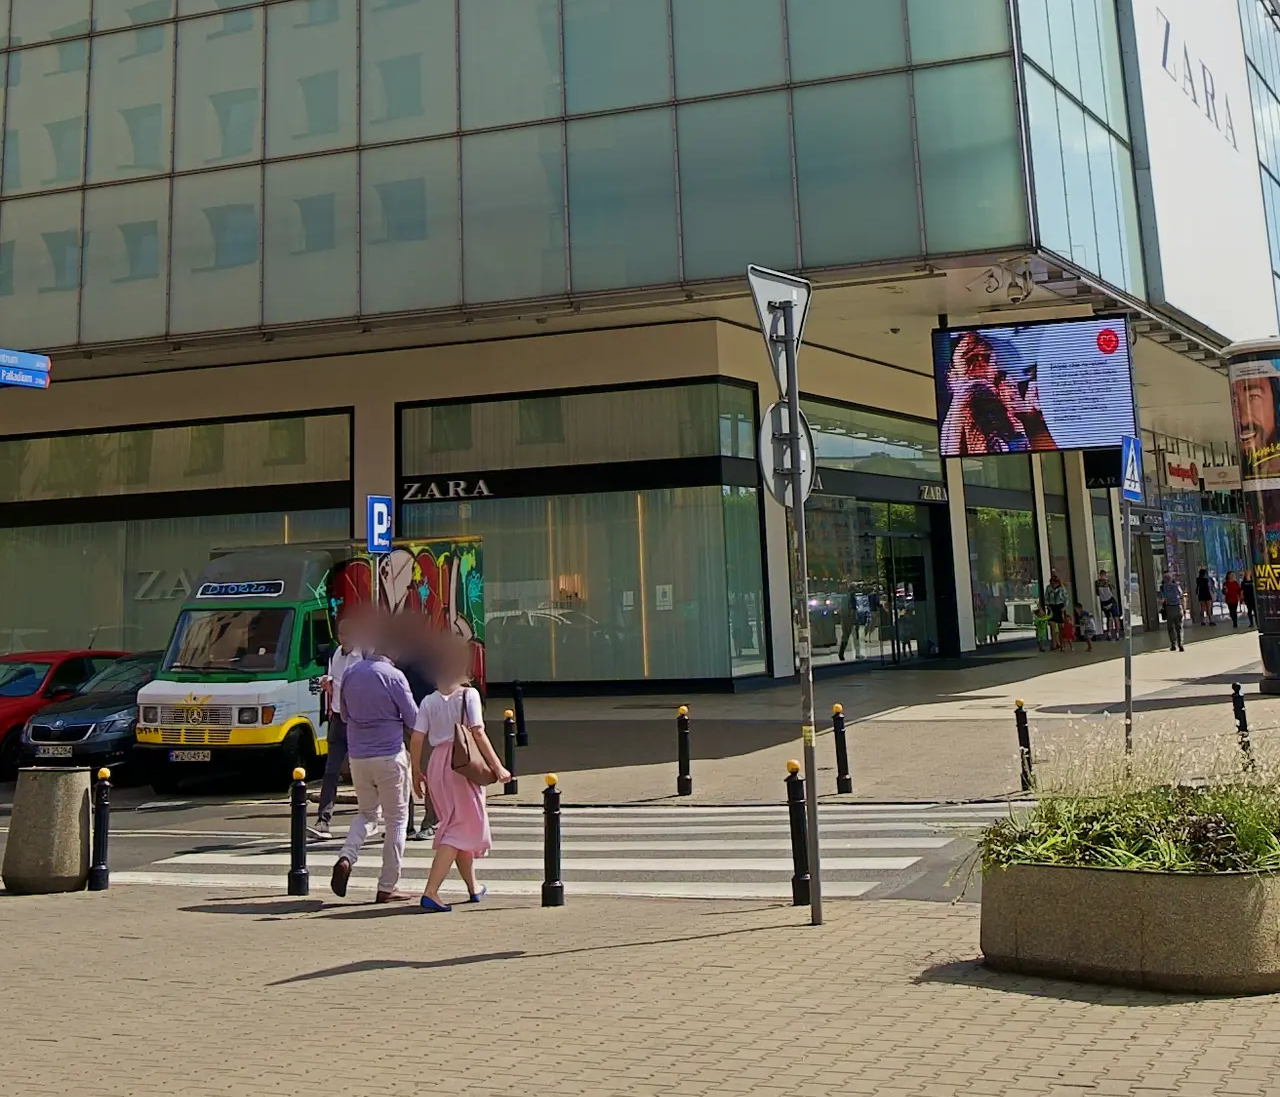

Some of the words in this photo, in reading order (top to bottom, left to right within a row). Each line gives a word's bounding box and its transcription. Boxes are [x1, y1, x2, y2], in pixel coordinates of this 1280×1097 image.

[1156, 6, 1240, 153] ZARA
[1, 369, 33, 383] Palladium
[403, 479, 494, 501] ZARA
[1087, 476, 1117, 485] ZAR
[373, 503, 388, 545] P
[134, 569, 192, 600] ZA
